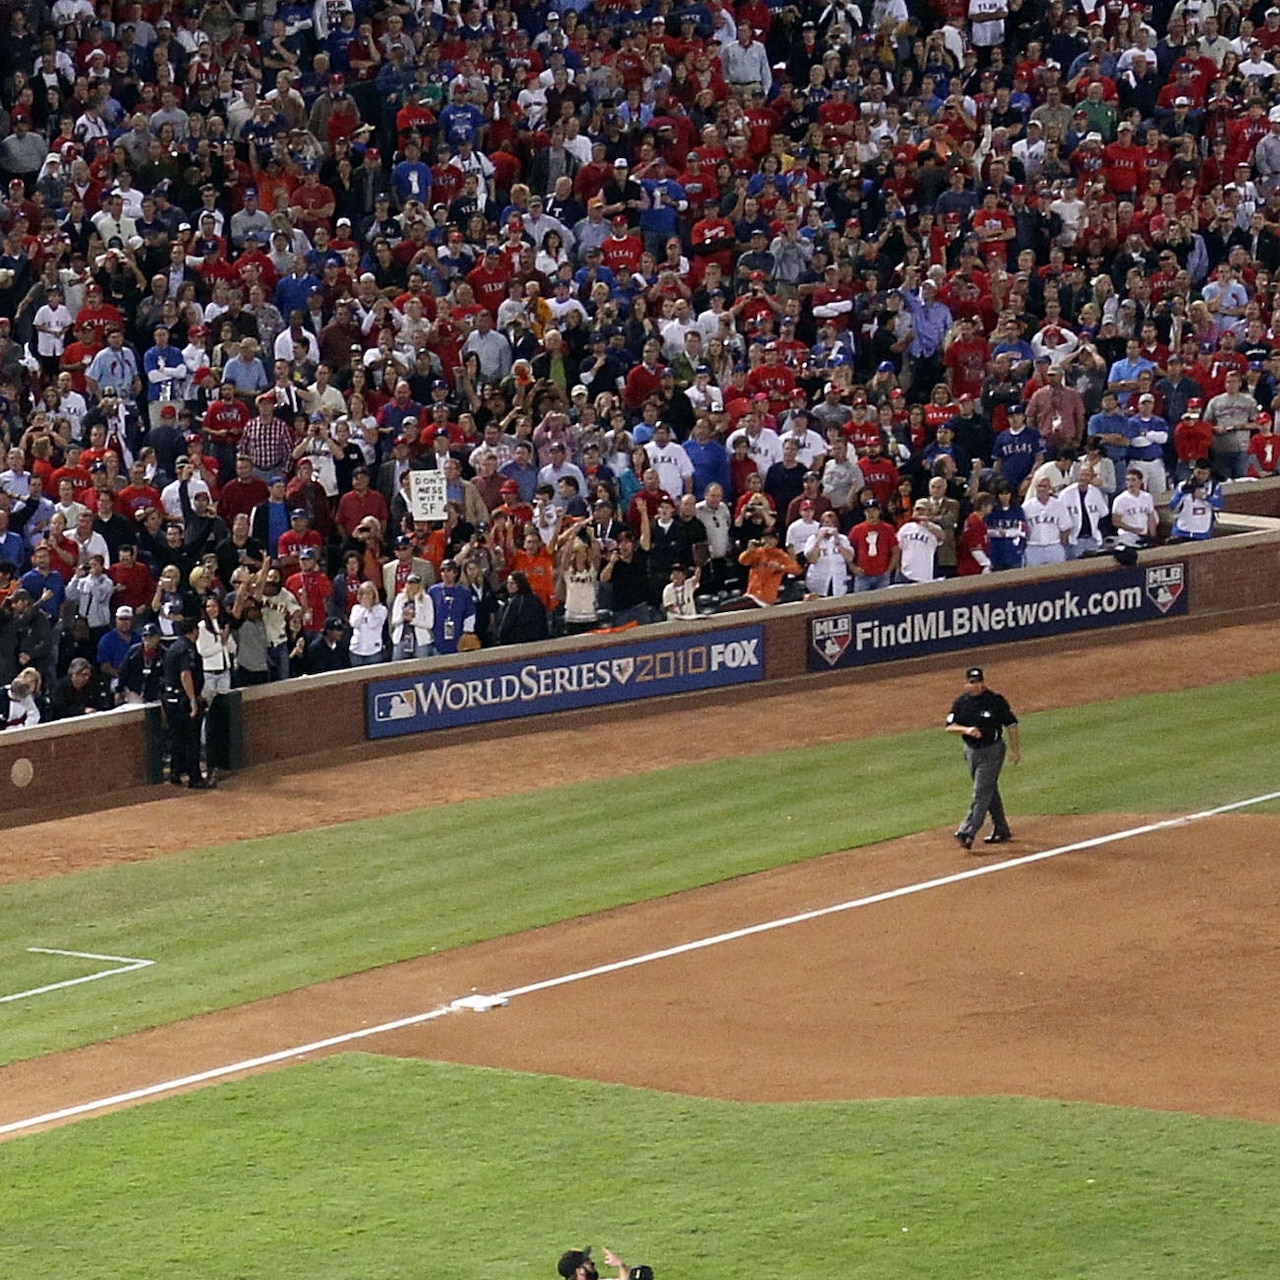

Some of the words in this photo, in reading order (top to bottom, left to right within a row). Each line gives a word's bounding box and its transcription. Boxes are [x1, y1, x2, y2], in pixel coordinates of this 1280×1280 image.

[608, 249, 634, 260] TEXAS
[482, 281, 507, 293] TEXAS
[1002, 443, 1033, 456] TEXAS
[418, 486, 443, 494] MESS
[421, 503, 436, 515] SF
[1028, 516, 1060, 527] TEXAS
[905, 533, 931, 544] TEXAS
[1148, 564, 1184, 584] MLB
[856, 586, 1142, 651] FindMLBNetwork.com
[814, 616, 851, 635] MLB
[635, 646, 707, 683] 2010
[710, 639, 759, 672] FOX
